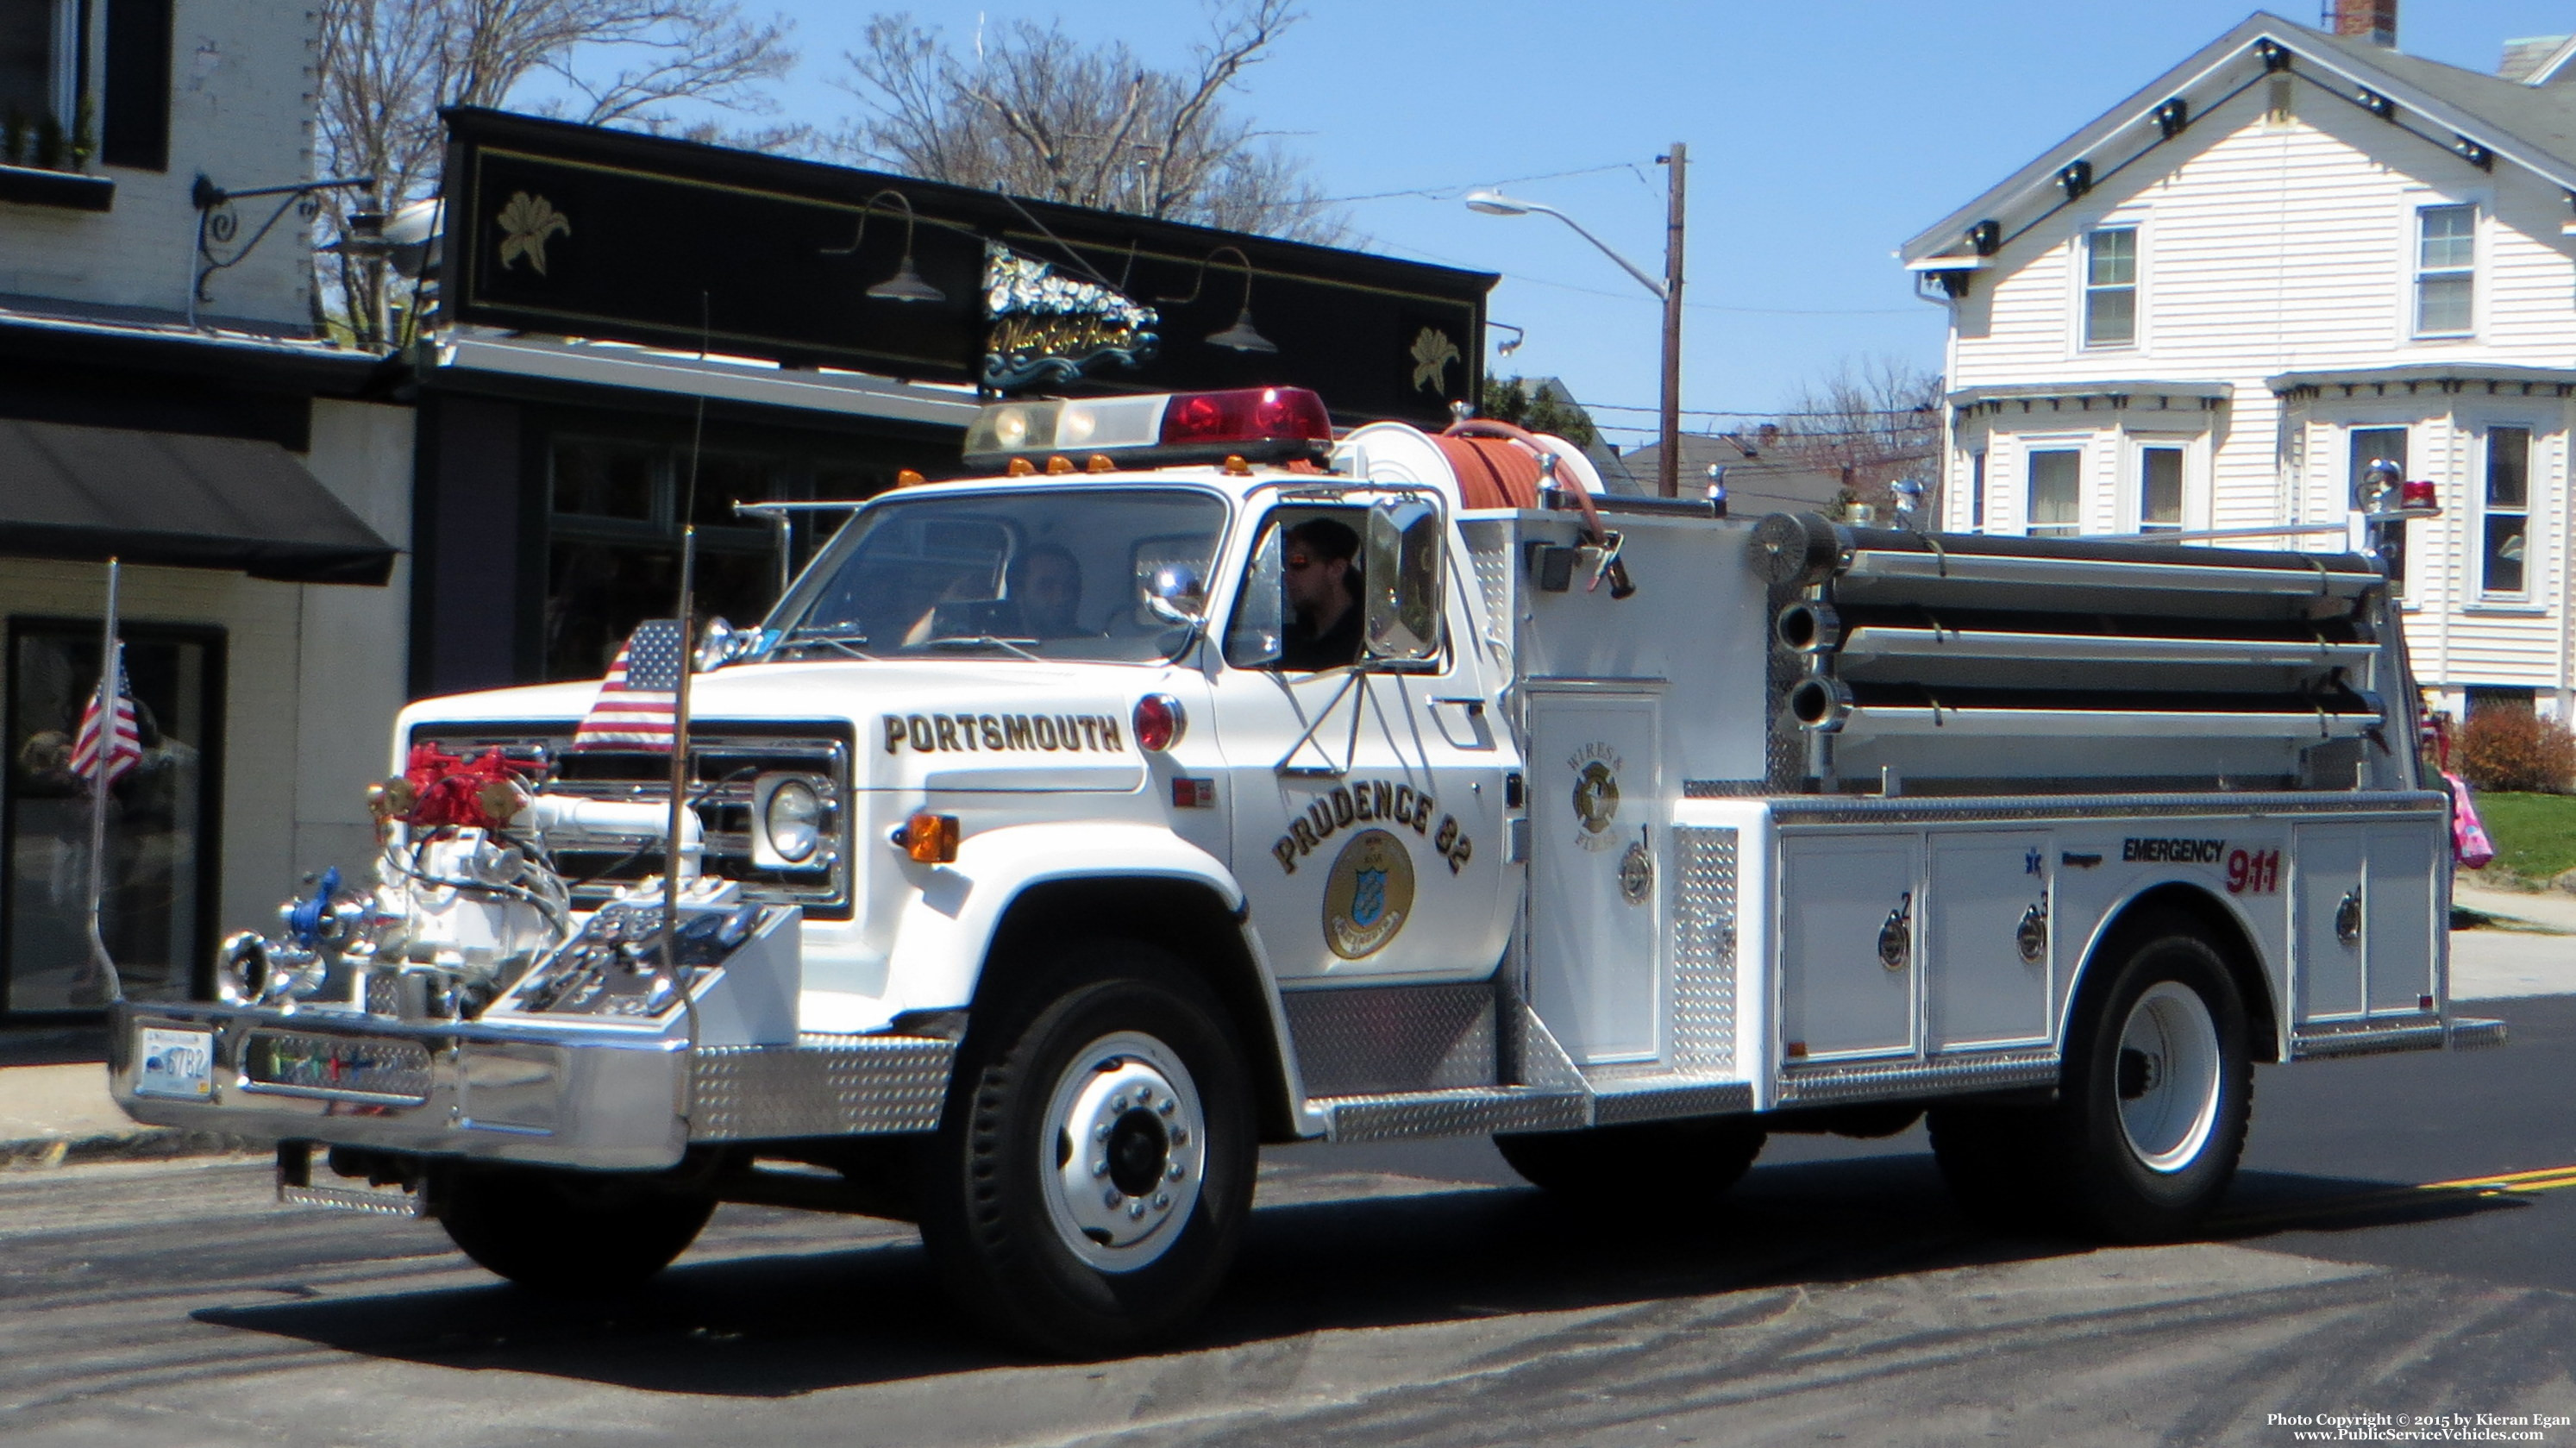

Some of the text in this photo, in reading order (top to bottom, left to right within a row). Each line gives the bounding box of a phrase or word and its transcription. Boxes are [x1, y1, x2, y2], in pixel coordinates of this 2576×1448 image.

[882, 714, 1125, 754] PORTSMOUTH
[1567, 742, 1614, 770] WIRES
[1272, 780, 1472, 876] PRUDENCE 82
[2123, 838, 2225, 862] EMERGENCY
[1901, 892, 1911, 919] 2
